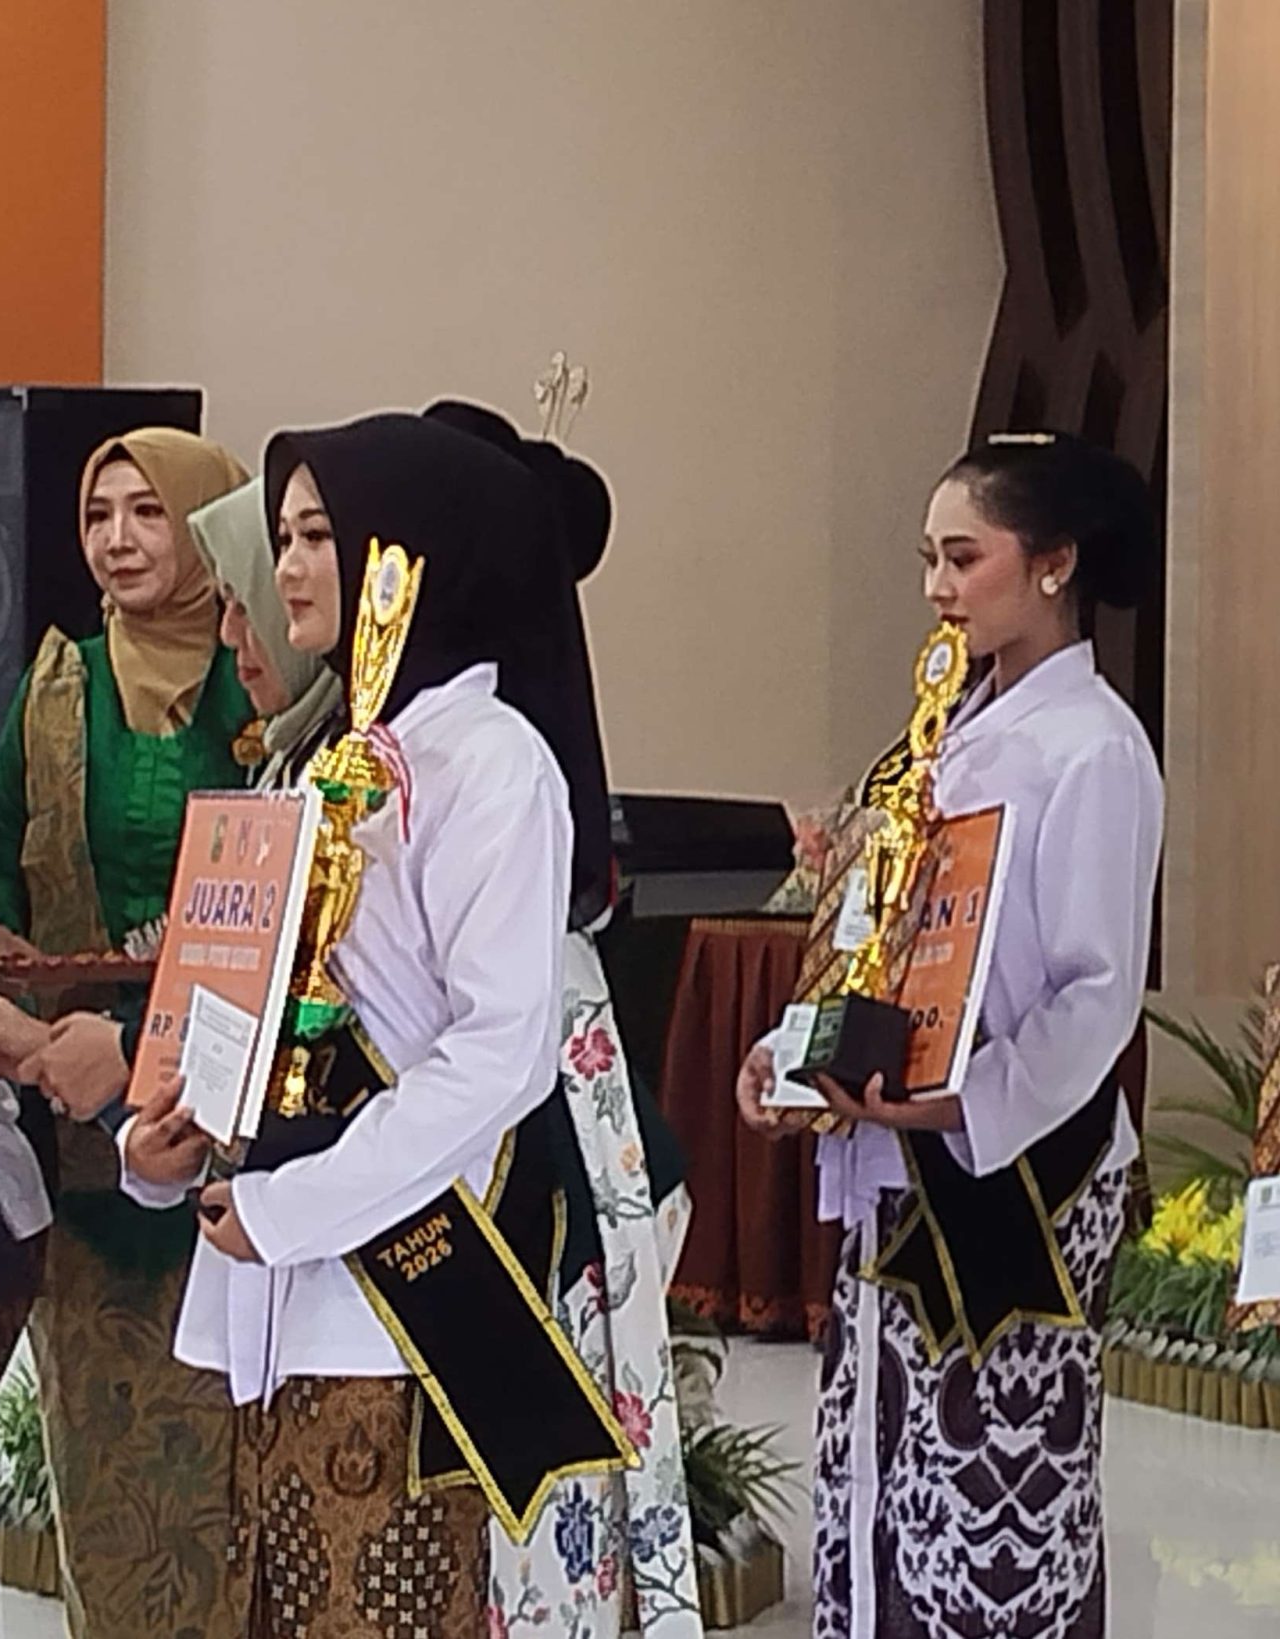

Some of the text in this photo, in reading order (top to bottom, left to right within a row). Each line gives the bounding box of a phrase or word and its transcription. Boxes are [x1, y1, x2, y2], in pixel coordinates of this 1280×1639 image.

[183, 879, 278, 931] JUARA 2
[966, 890, 983, 926] 1
[376, 1212, 453, 1269] TAHUN
[400, 1236, 453, 1283] 2026
